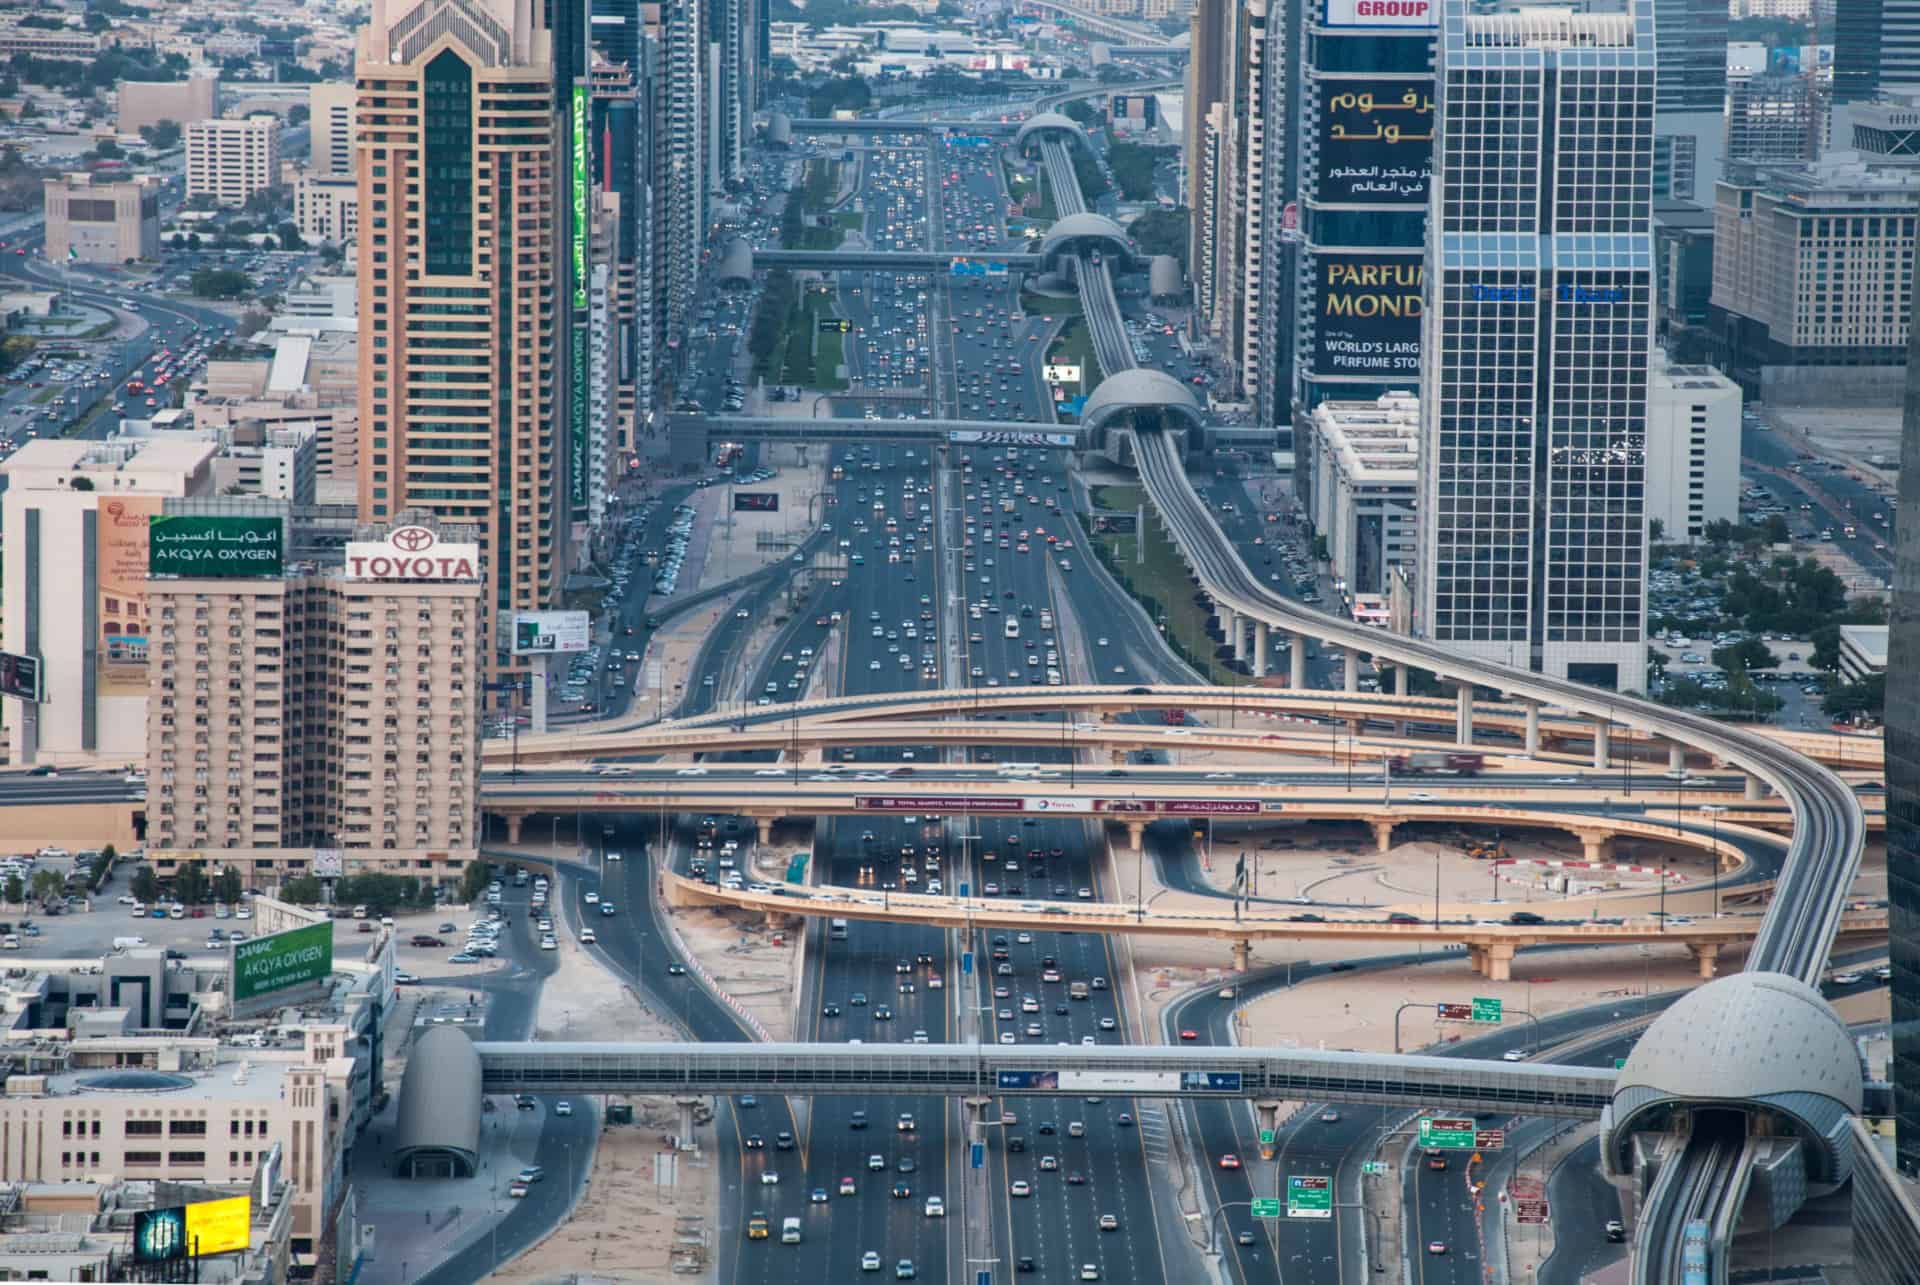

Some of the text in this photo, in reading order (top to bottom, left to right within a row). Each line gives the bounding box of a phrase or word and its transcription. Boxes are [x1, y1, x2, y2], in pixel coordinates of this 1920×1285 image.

[1357, 1, 1428, 16] GROUP
[1330, 87, 1436, 113] رفوم
[1328, 165, 1378, 178] العطور
[1351, 181, 1424, 196] في العالم
[1326, 341, 1382, 353] WORLD'S
[1333, 356, 1391, 368] PERFUME
[156, 549, 277, 561] AKQYA OXYGEN
[350, 557, 473, 577] TOYOTA
